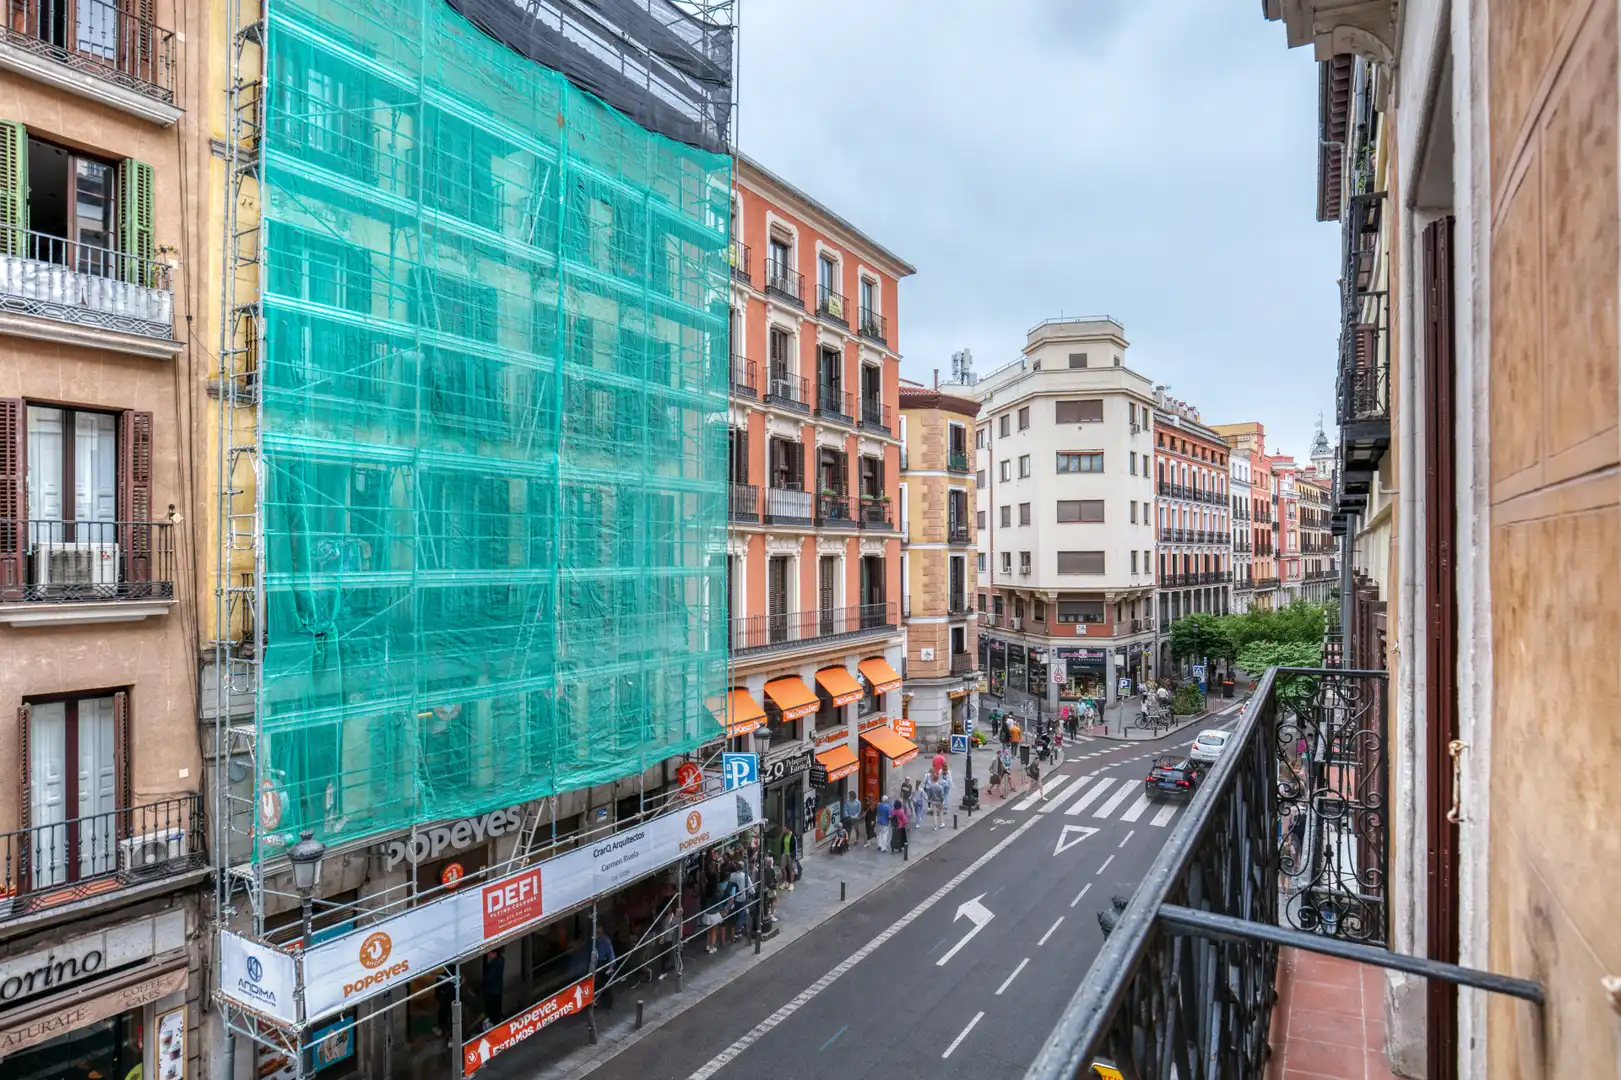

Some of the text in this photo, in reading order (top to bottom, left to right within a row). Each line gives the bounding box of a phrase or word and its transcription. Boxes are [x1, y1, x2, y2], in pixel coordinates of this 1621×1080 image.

[612, 831, 645, 851] Arquitectos
[601, 857, 623, 872] Carmen
[487, 875, 538, 914] DEFI
[1, 951, 102, 1000] orino
[126, 990, 161, 1008] CAKES
[492, 1001, 574, 1056] ESTAMOS ABIERTOS
